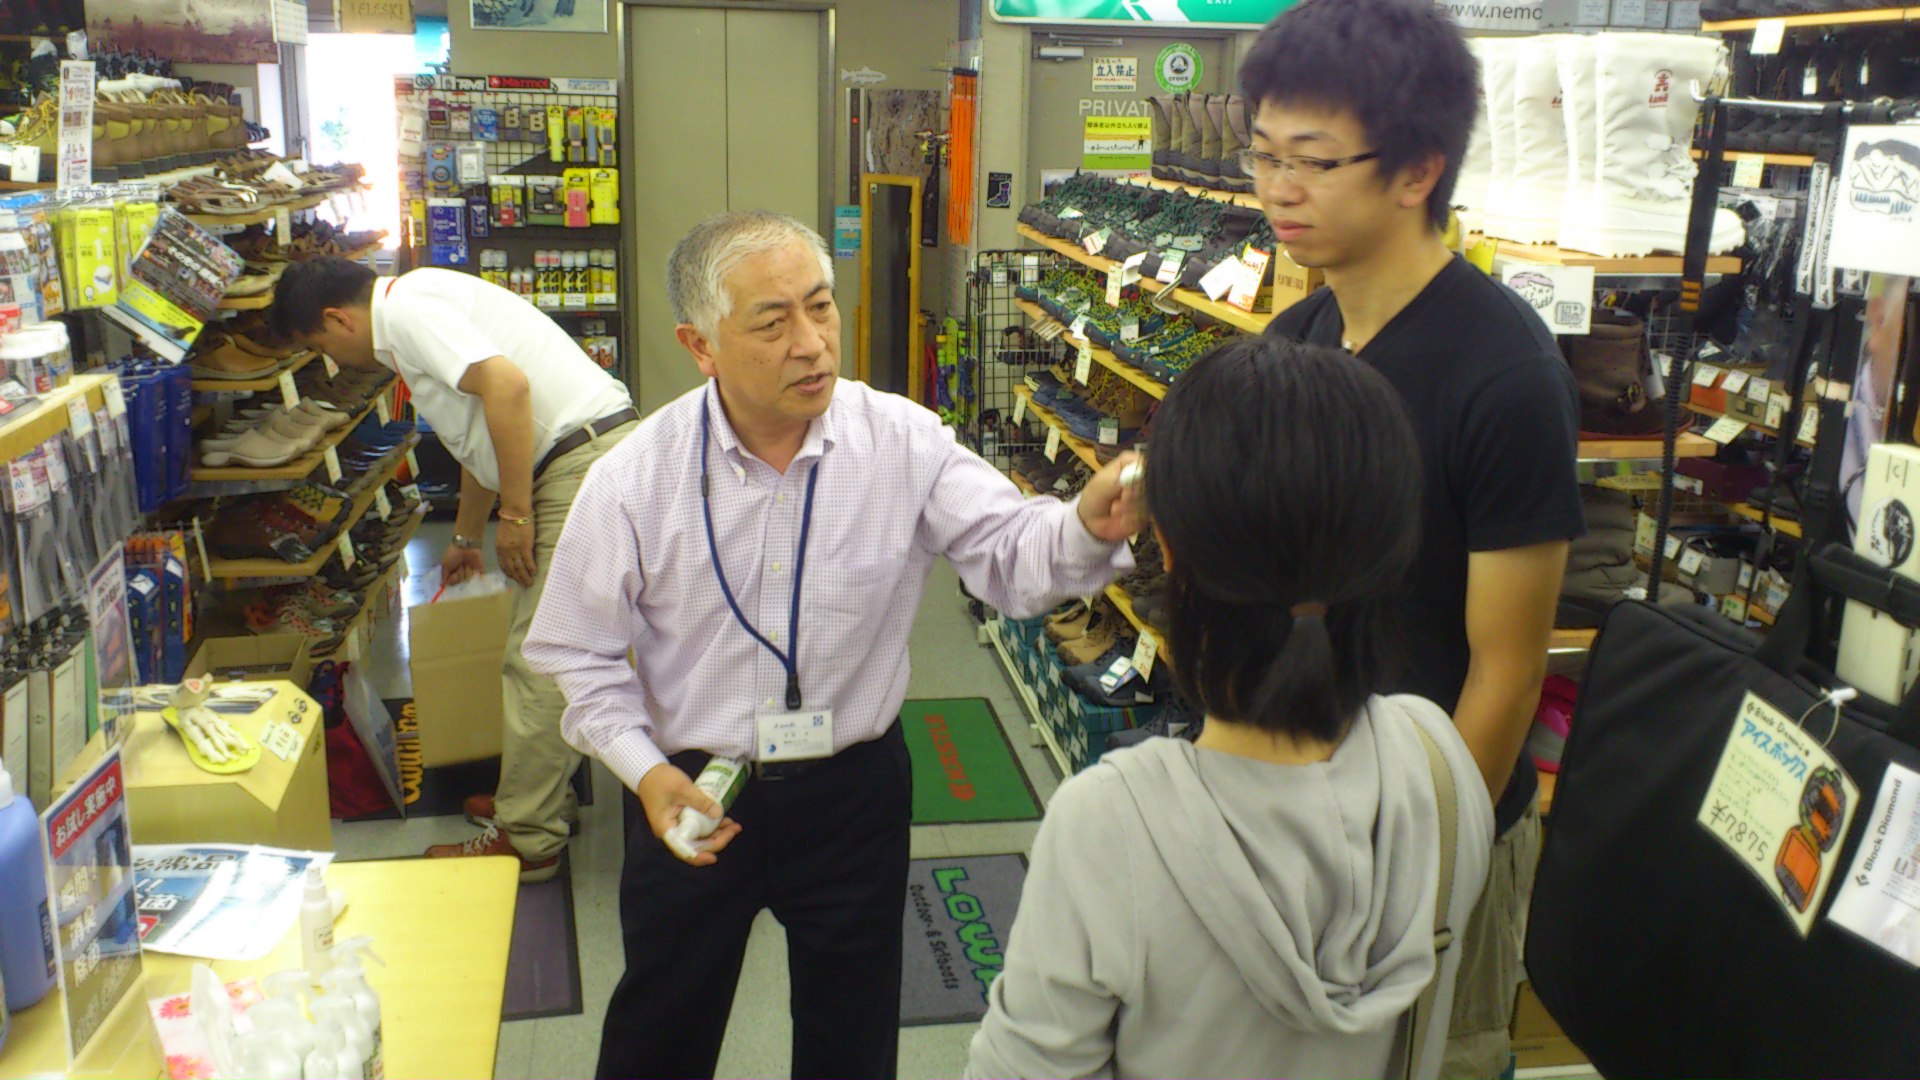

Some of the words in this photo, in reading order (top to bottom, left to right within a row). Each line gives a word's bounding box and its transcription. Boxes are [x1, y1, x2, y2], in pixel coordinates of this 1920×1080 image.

[1096, 64, 1136, 77] 立入禁止
[1755, 706, 1775, 727] Black
[54, 781, 117, 849] お試し実施中
[1864, 833, 1884, 872] Black
[1877, 778, 1903, 837] Diamond
